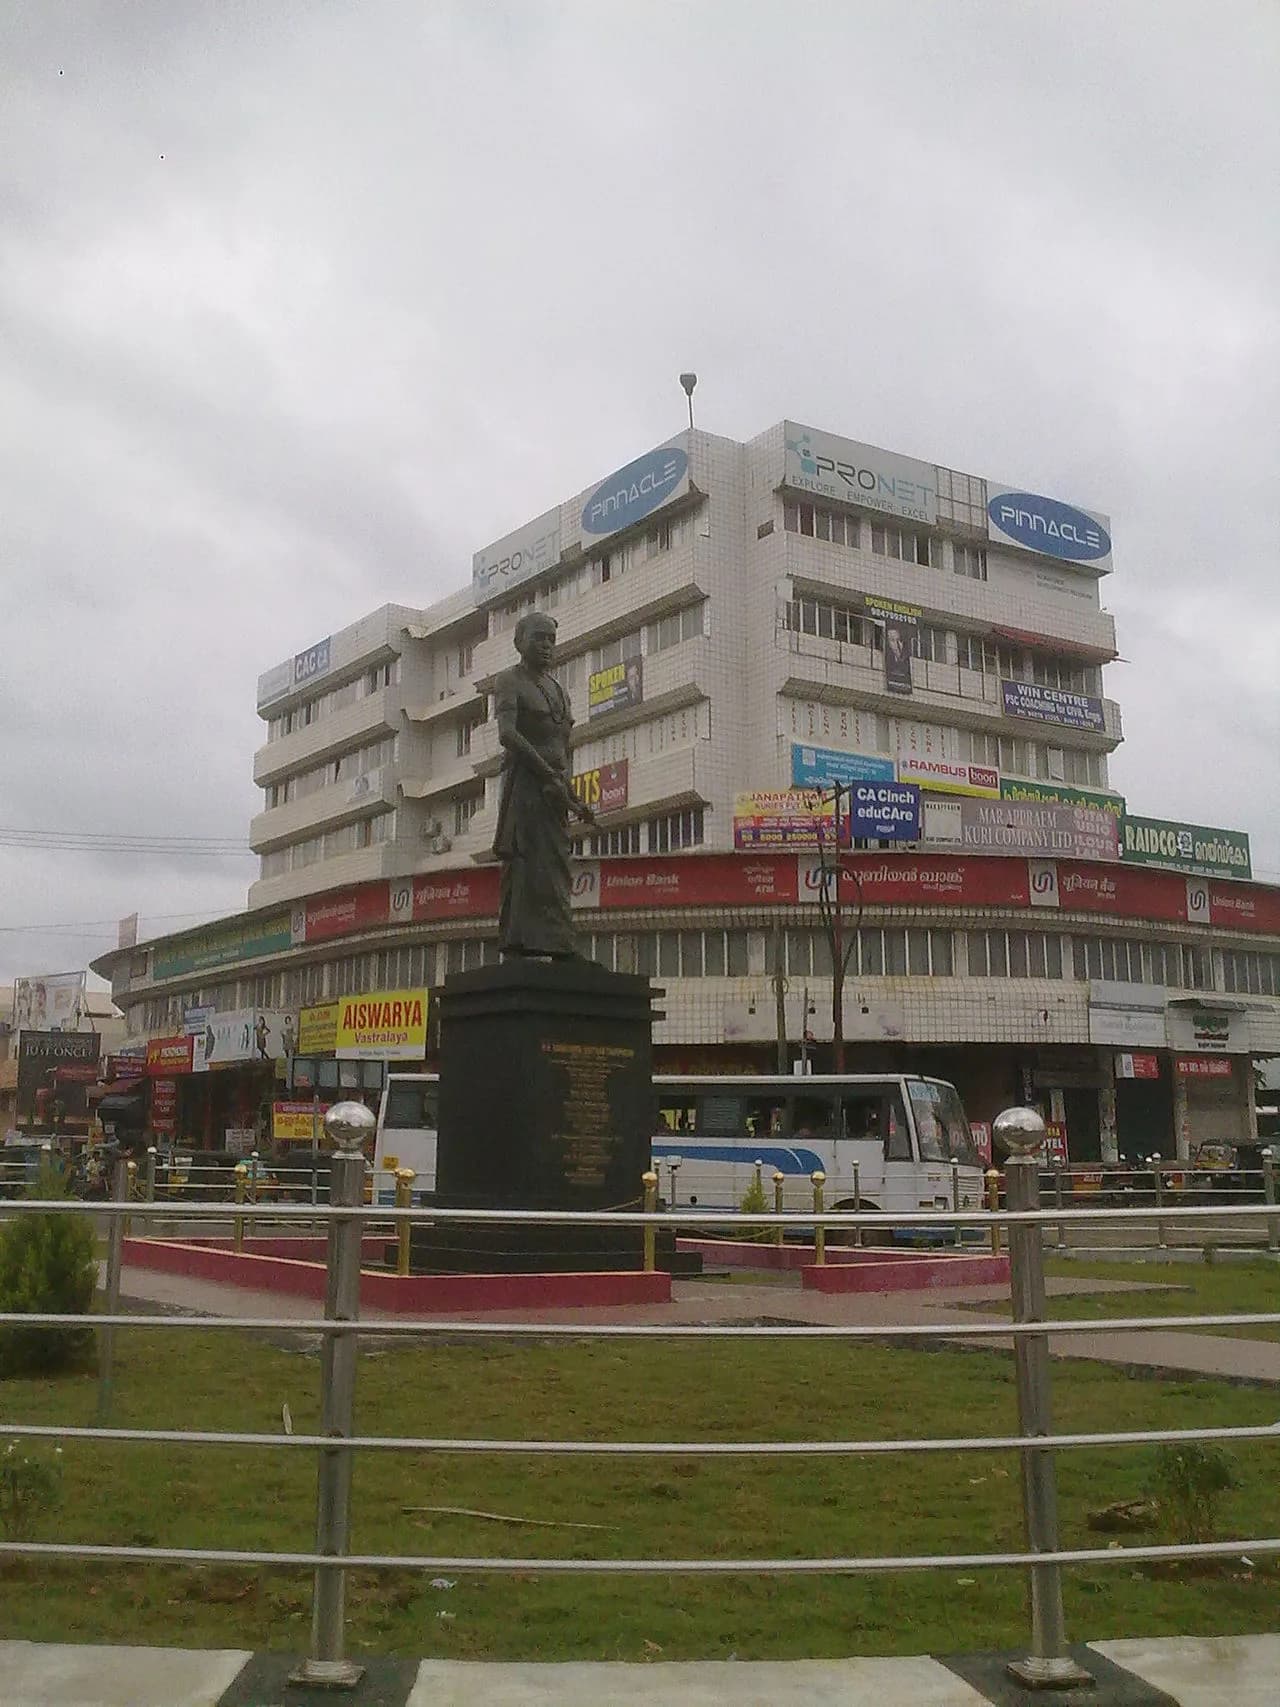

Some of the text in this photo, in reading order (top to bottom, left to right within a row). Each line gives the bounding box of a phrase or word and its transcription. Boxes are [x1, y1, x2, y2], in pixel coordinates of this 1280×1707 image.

[592, 460, 676, 522] PINNACLE
[816, 456, 934, 506] PRONET
[792, 475, 835, 496] EXPLORE
[902, 505, 929, 521] EXCEL
[1001, 505, 1100, 549] PINNACLE
[1017, 685, 1089, 707] WIN CENTRE
[909, 760, 967, 778] RAMBUS
[856, 787, 876, 801] CA
[857, 806, 914, 822] eduCAre
[978, 807, 1058, 829] MAR APPRAEM
[964, 826, 1072, 850] KURI COMPANY LTD
[1125, 825, 1177, 857] RAIDCO
[607, 873, 680, 888] Union Bank
[342, 1000, 423, 1030] AISWARYA
[354, 1030, 408, 1045] Vastralaya
